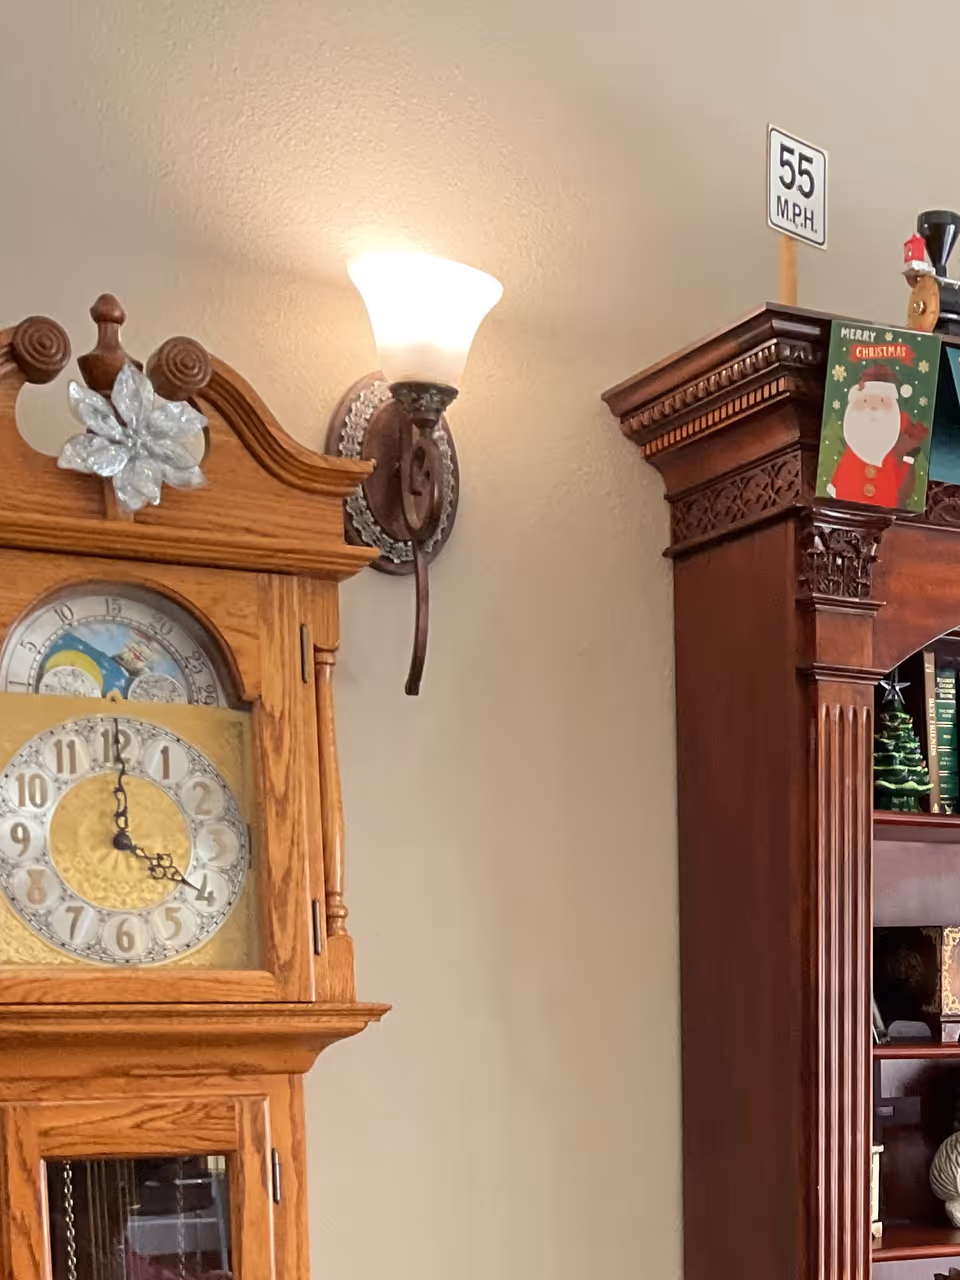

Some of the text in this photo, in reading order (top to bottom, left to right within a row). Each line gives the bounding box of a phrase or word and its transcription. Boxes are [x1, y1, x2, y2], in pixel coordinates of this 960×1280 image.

[779, 142, 815, 199] 55
[776, 195, 818, 234] M.P.H.
[840, 326, 877, 343] MERRY
[855, 346, 906, 358] CHRISTMAS
[54, 602, 75, 625] 10
[104, 597, 122, 616] 15
[20, 639, 38, 653] 5
[185, 649, 207, 674] 25
[928, 697, 938, 756] BEST FRIENDS
[53, 738, 77, 775] 11
[100, 728, 132, 764] 12
[160, 745, 170, 780] 1
[15, 772, 48, 808] 10
[192, 781, 212, 816] 2
[10, 822, 31, 857] 9
[206, 828, 228, 862] 3
[26, 868, 47, 906] 8
[194, 872, 217, 907] 4
[65, 905, 84, 941] 7
[115, 918, 135, 953] 6
[164, 906, 182, 941] 5
